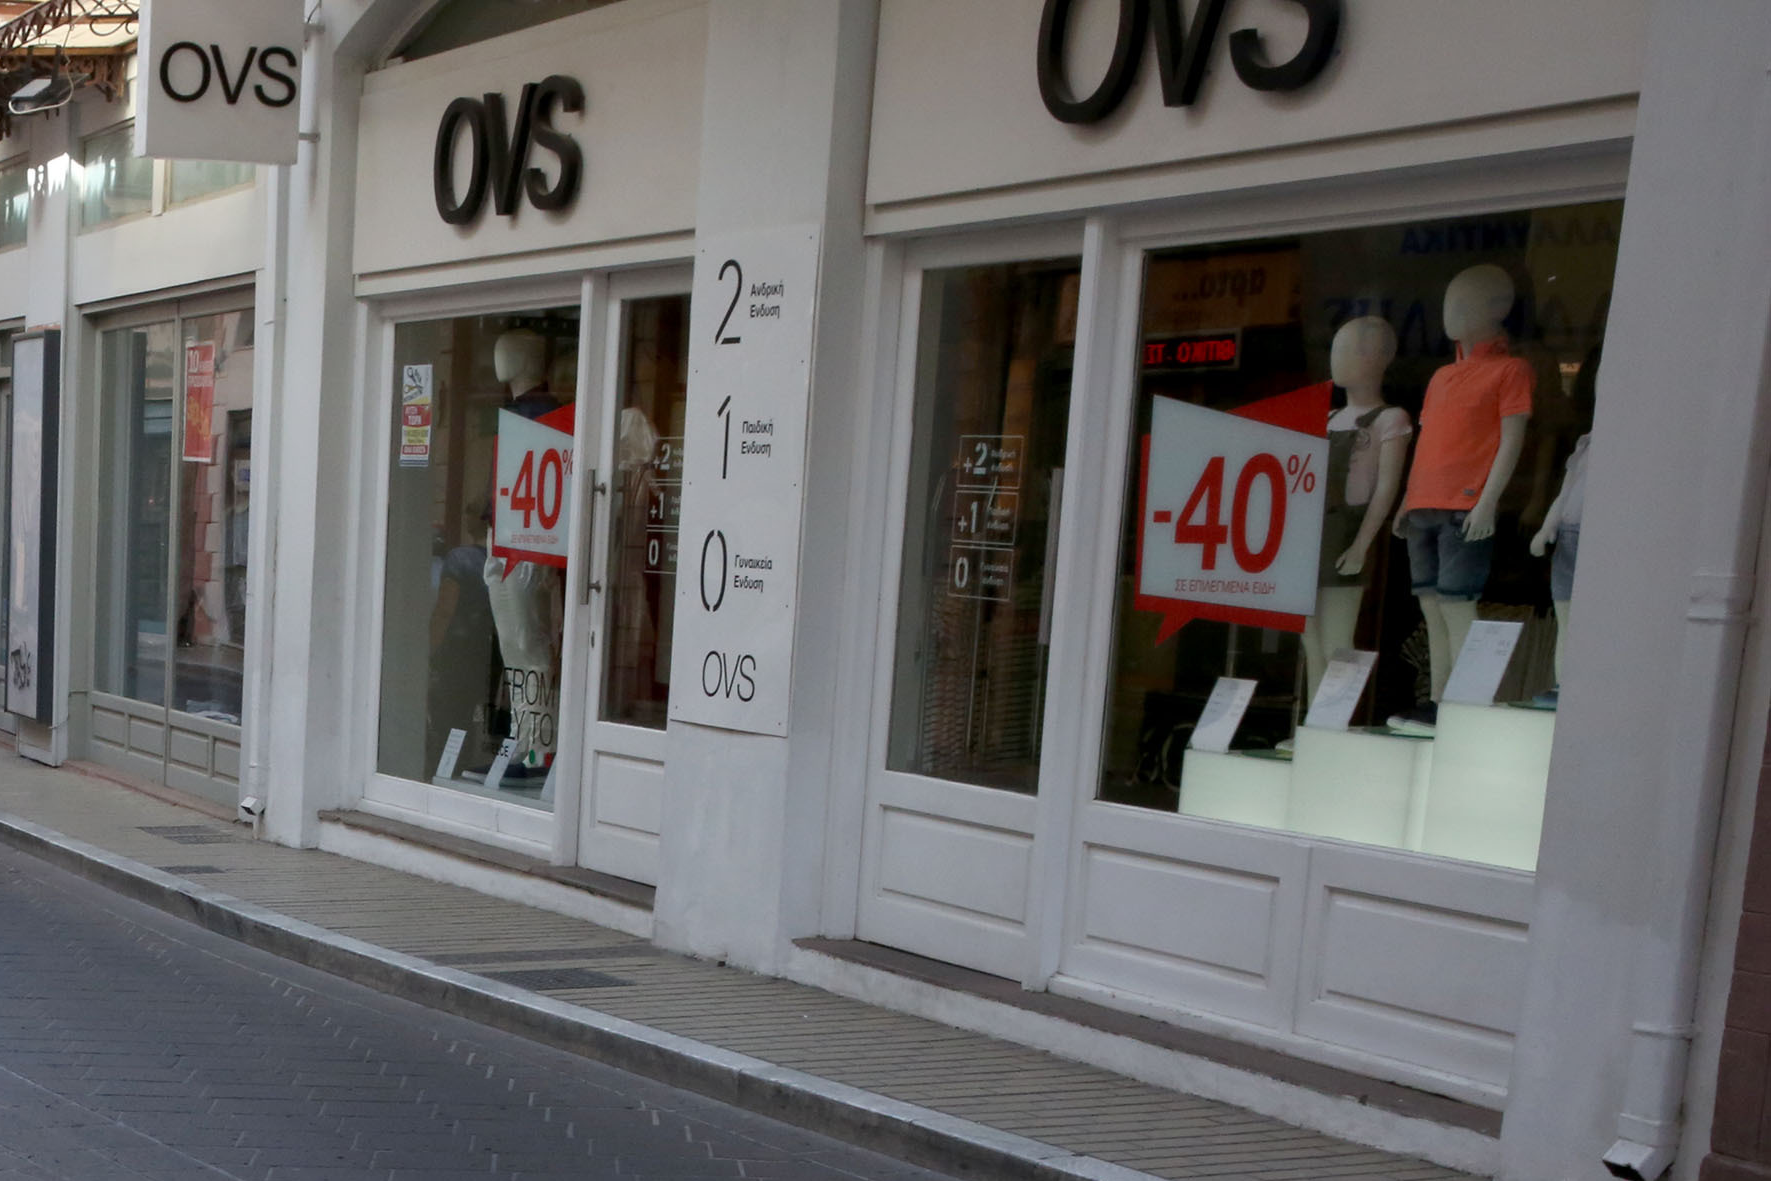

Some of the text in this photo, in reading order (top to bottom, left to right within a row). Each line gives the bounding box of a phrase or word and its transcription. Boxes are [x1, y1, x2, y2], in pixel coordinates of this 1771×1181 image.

[159, 41, 297, 107] OVS
[1038, 0, 1342, 125] OVS
[433, 75, 587, 226] OVS
[714, 259, 743, 346] 2
[750, 280, 784, 299] Ανδρική
[750, 304, 780, 319] Ενδυση
[717, 395, 732, 479] 1
[741, 441, 771, 458] Ενδυση
[742, 418, 774, 436] Παιδική
[499, 448, 572, 530] -40%
[1153, 451, 1316, 574] -40%
[701, 529, 728, 612] 0
[734, 575, 764, 593] Ενδυση
[735, 554, 773, 570] Γυναικεία
[1174, 579, 1276, 594] ΣΕ ΕΠΙΛΕΓΜΕΝΑ ΕΙΔΗ
[503, 667, 557, 707] FROM
[702, 650, 757, 703] OVS
[529, 711, 554, 747] TO
